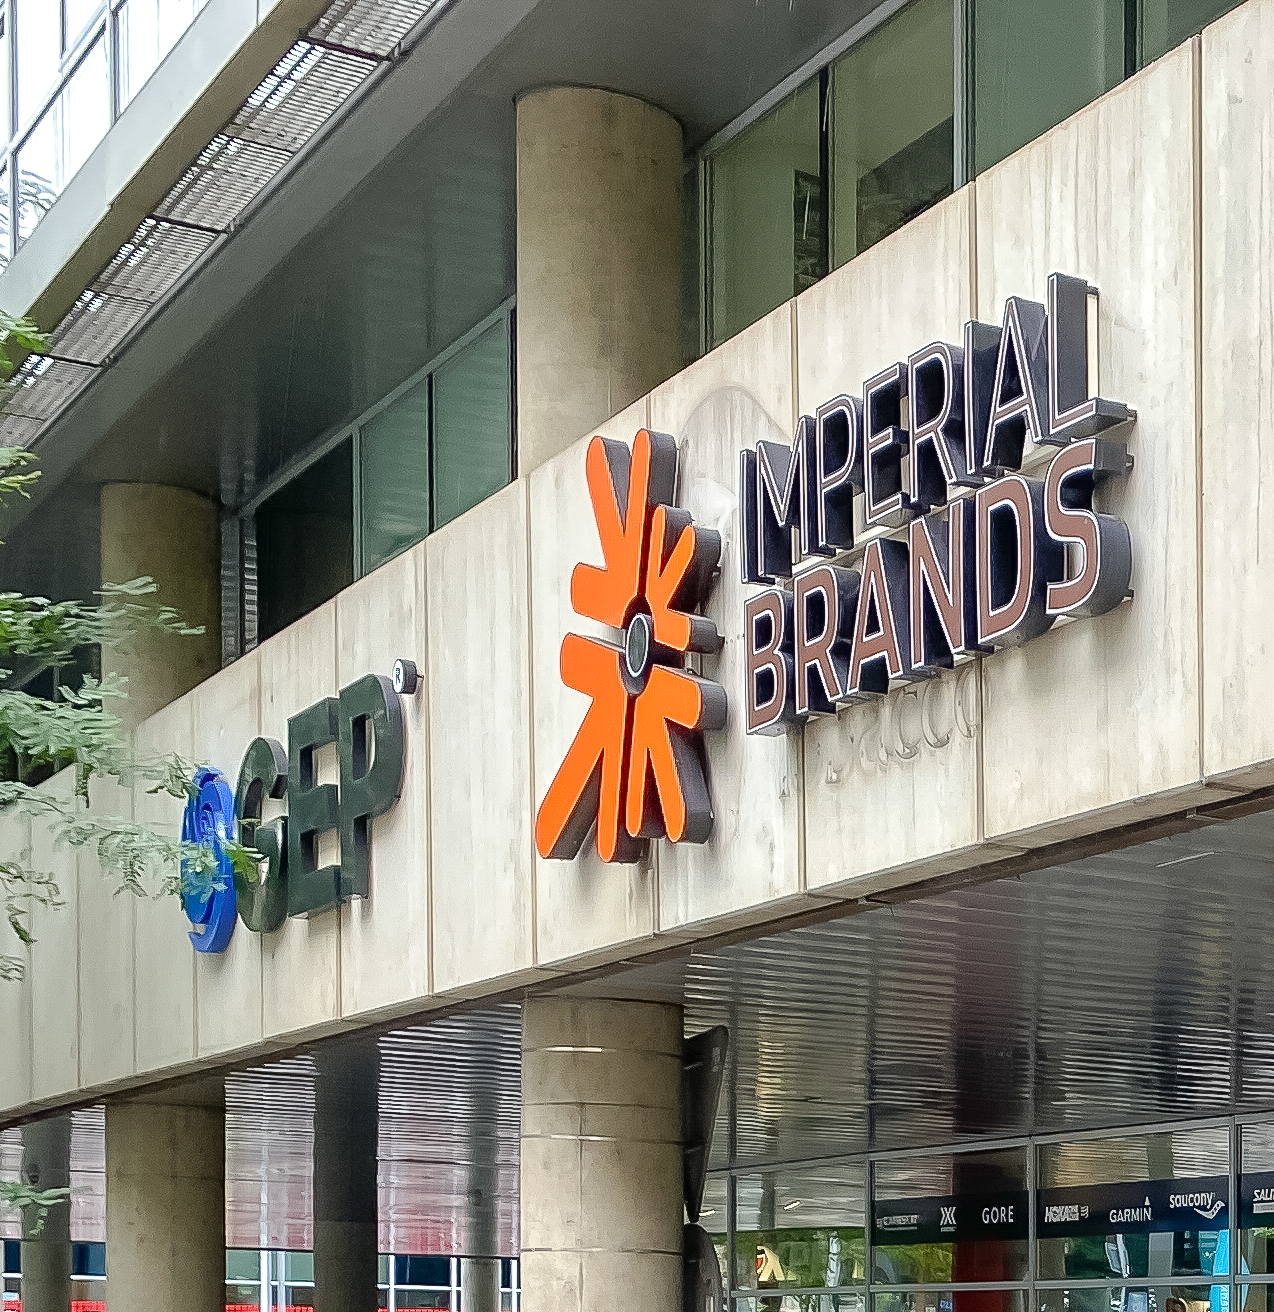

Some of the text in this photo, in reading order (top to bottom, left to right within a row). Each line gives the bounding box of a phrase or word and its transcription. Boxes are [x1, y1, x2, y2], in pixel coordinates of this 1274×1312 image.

[739, 273, 1100, 584] IMPERIAL
[745, 438, 1102, 736] BRANDS
[235, 673, 403, 934] GEP
[981, 1205, 1014, 1224] GORE
[1109, 1207, 1152, 1223] GARMIN
[1169, 1192, 1213, 1209] saucony
